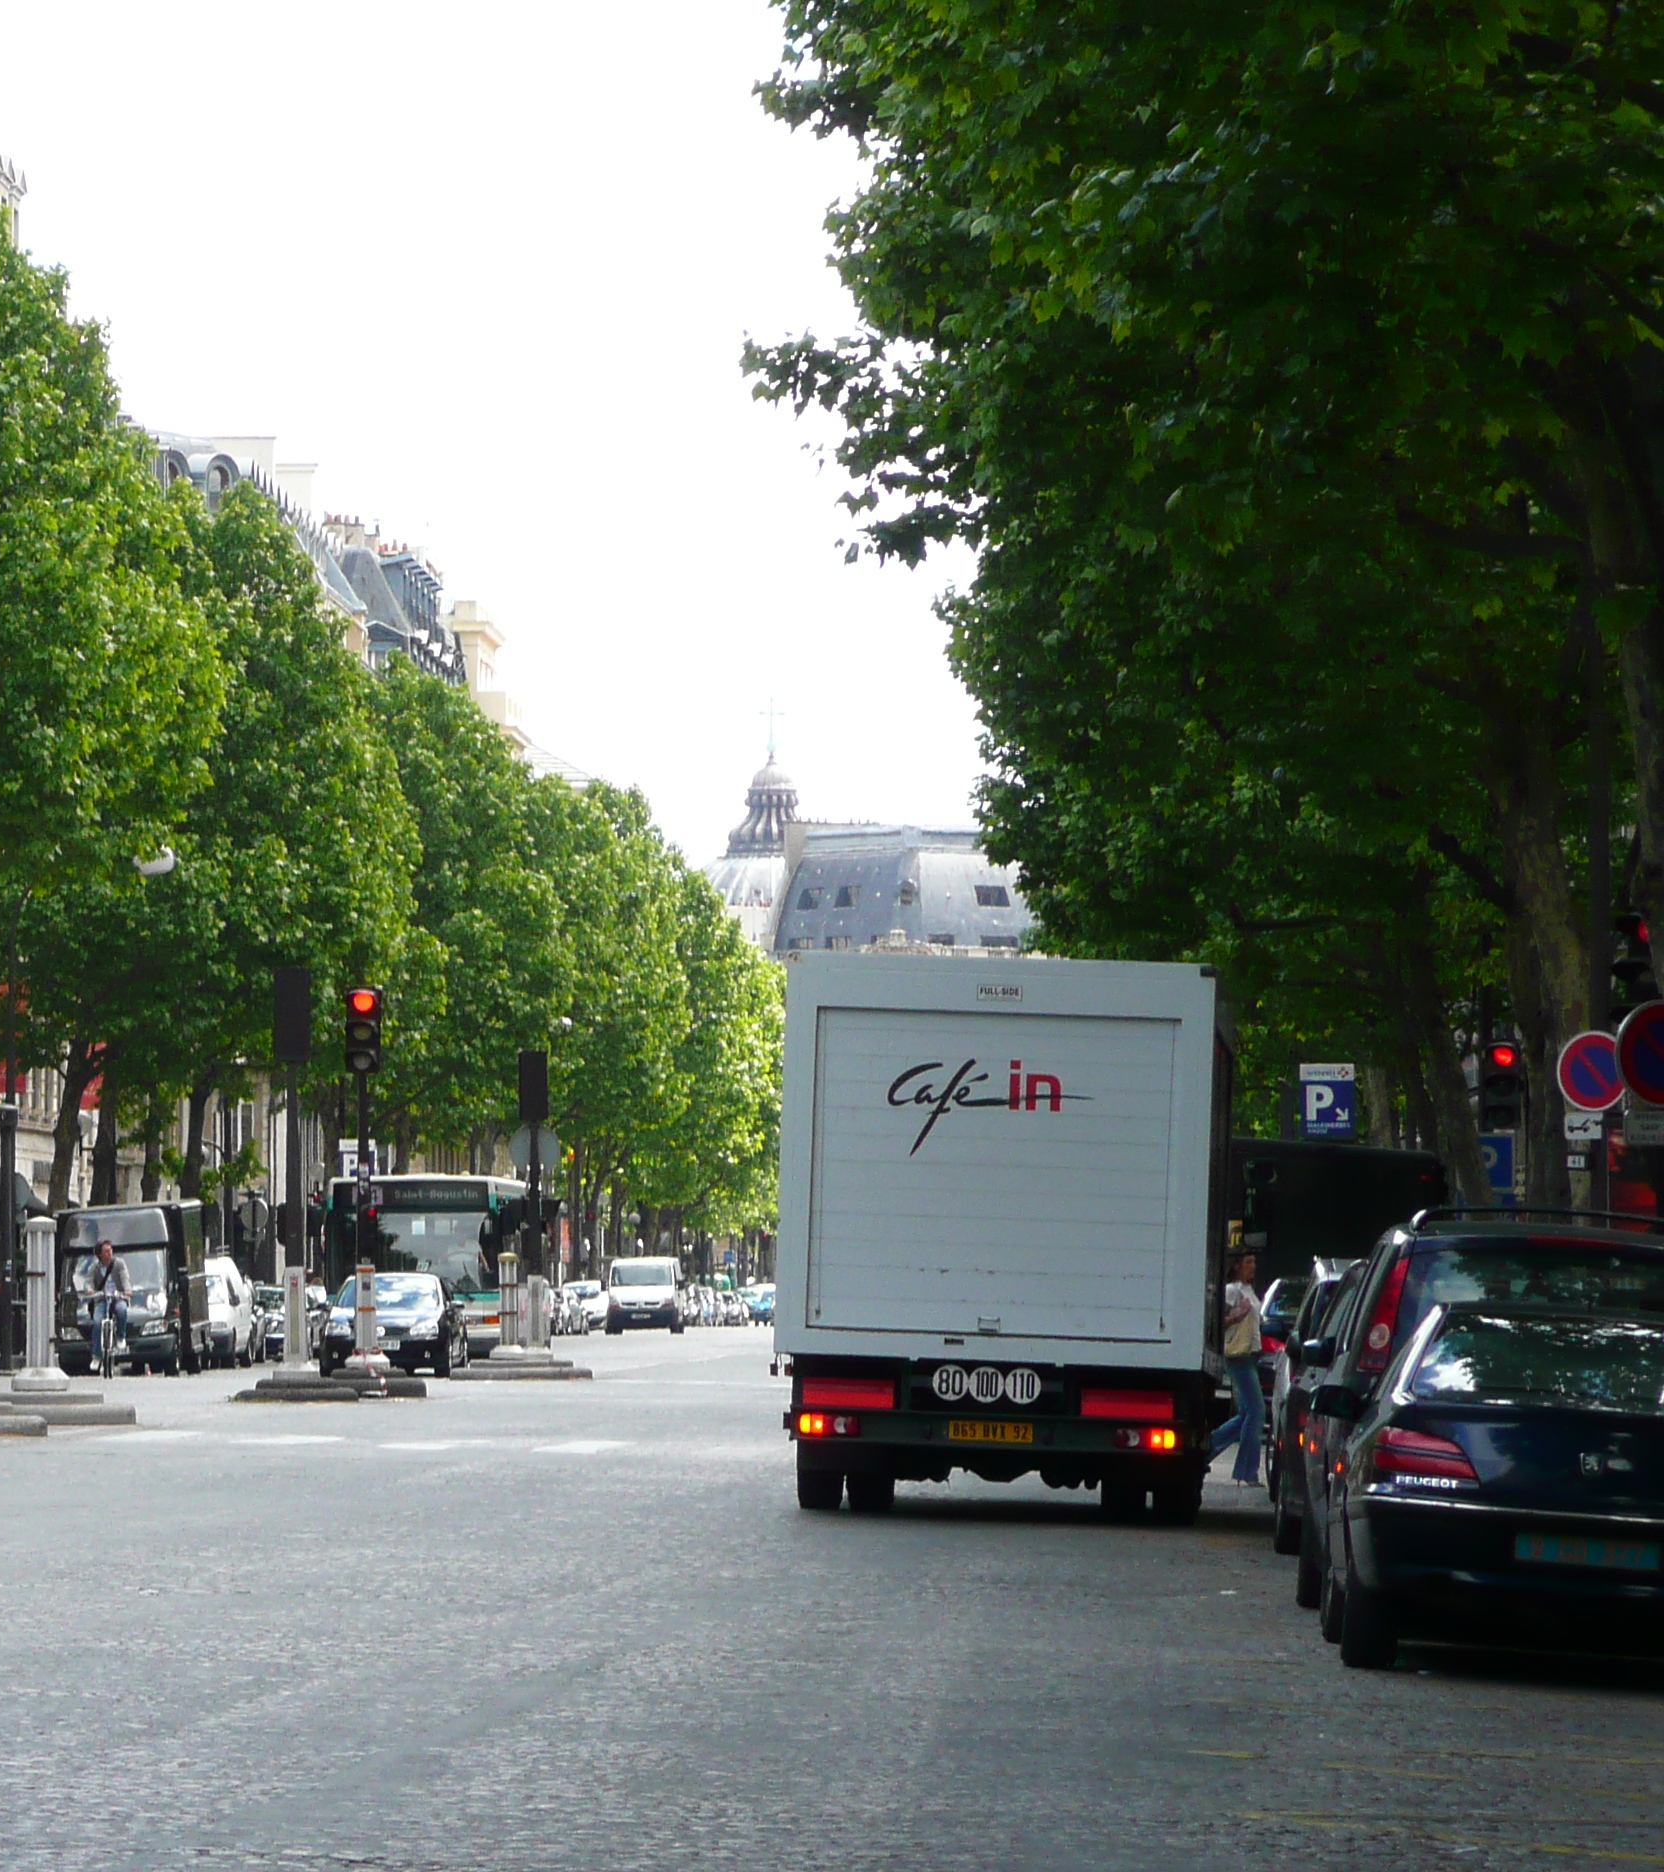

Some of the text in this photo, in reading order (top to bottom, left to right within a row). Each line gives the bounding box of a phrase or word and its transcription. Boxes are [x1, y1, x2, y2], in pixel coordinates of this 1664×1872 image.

[887, 1057, 1063, 1158] Café in
[1306, 1084, 1334, 1121] P
[938, 1369, 964, 1396] 80
[976, 1370, 999, 1398] 100
[1012, 1372, 1035, 1399] 110
[1396, 1475, 1459, 1489] PEUGEOT
